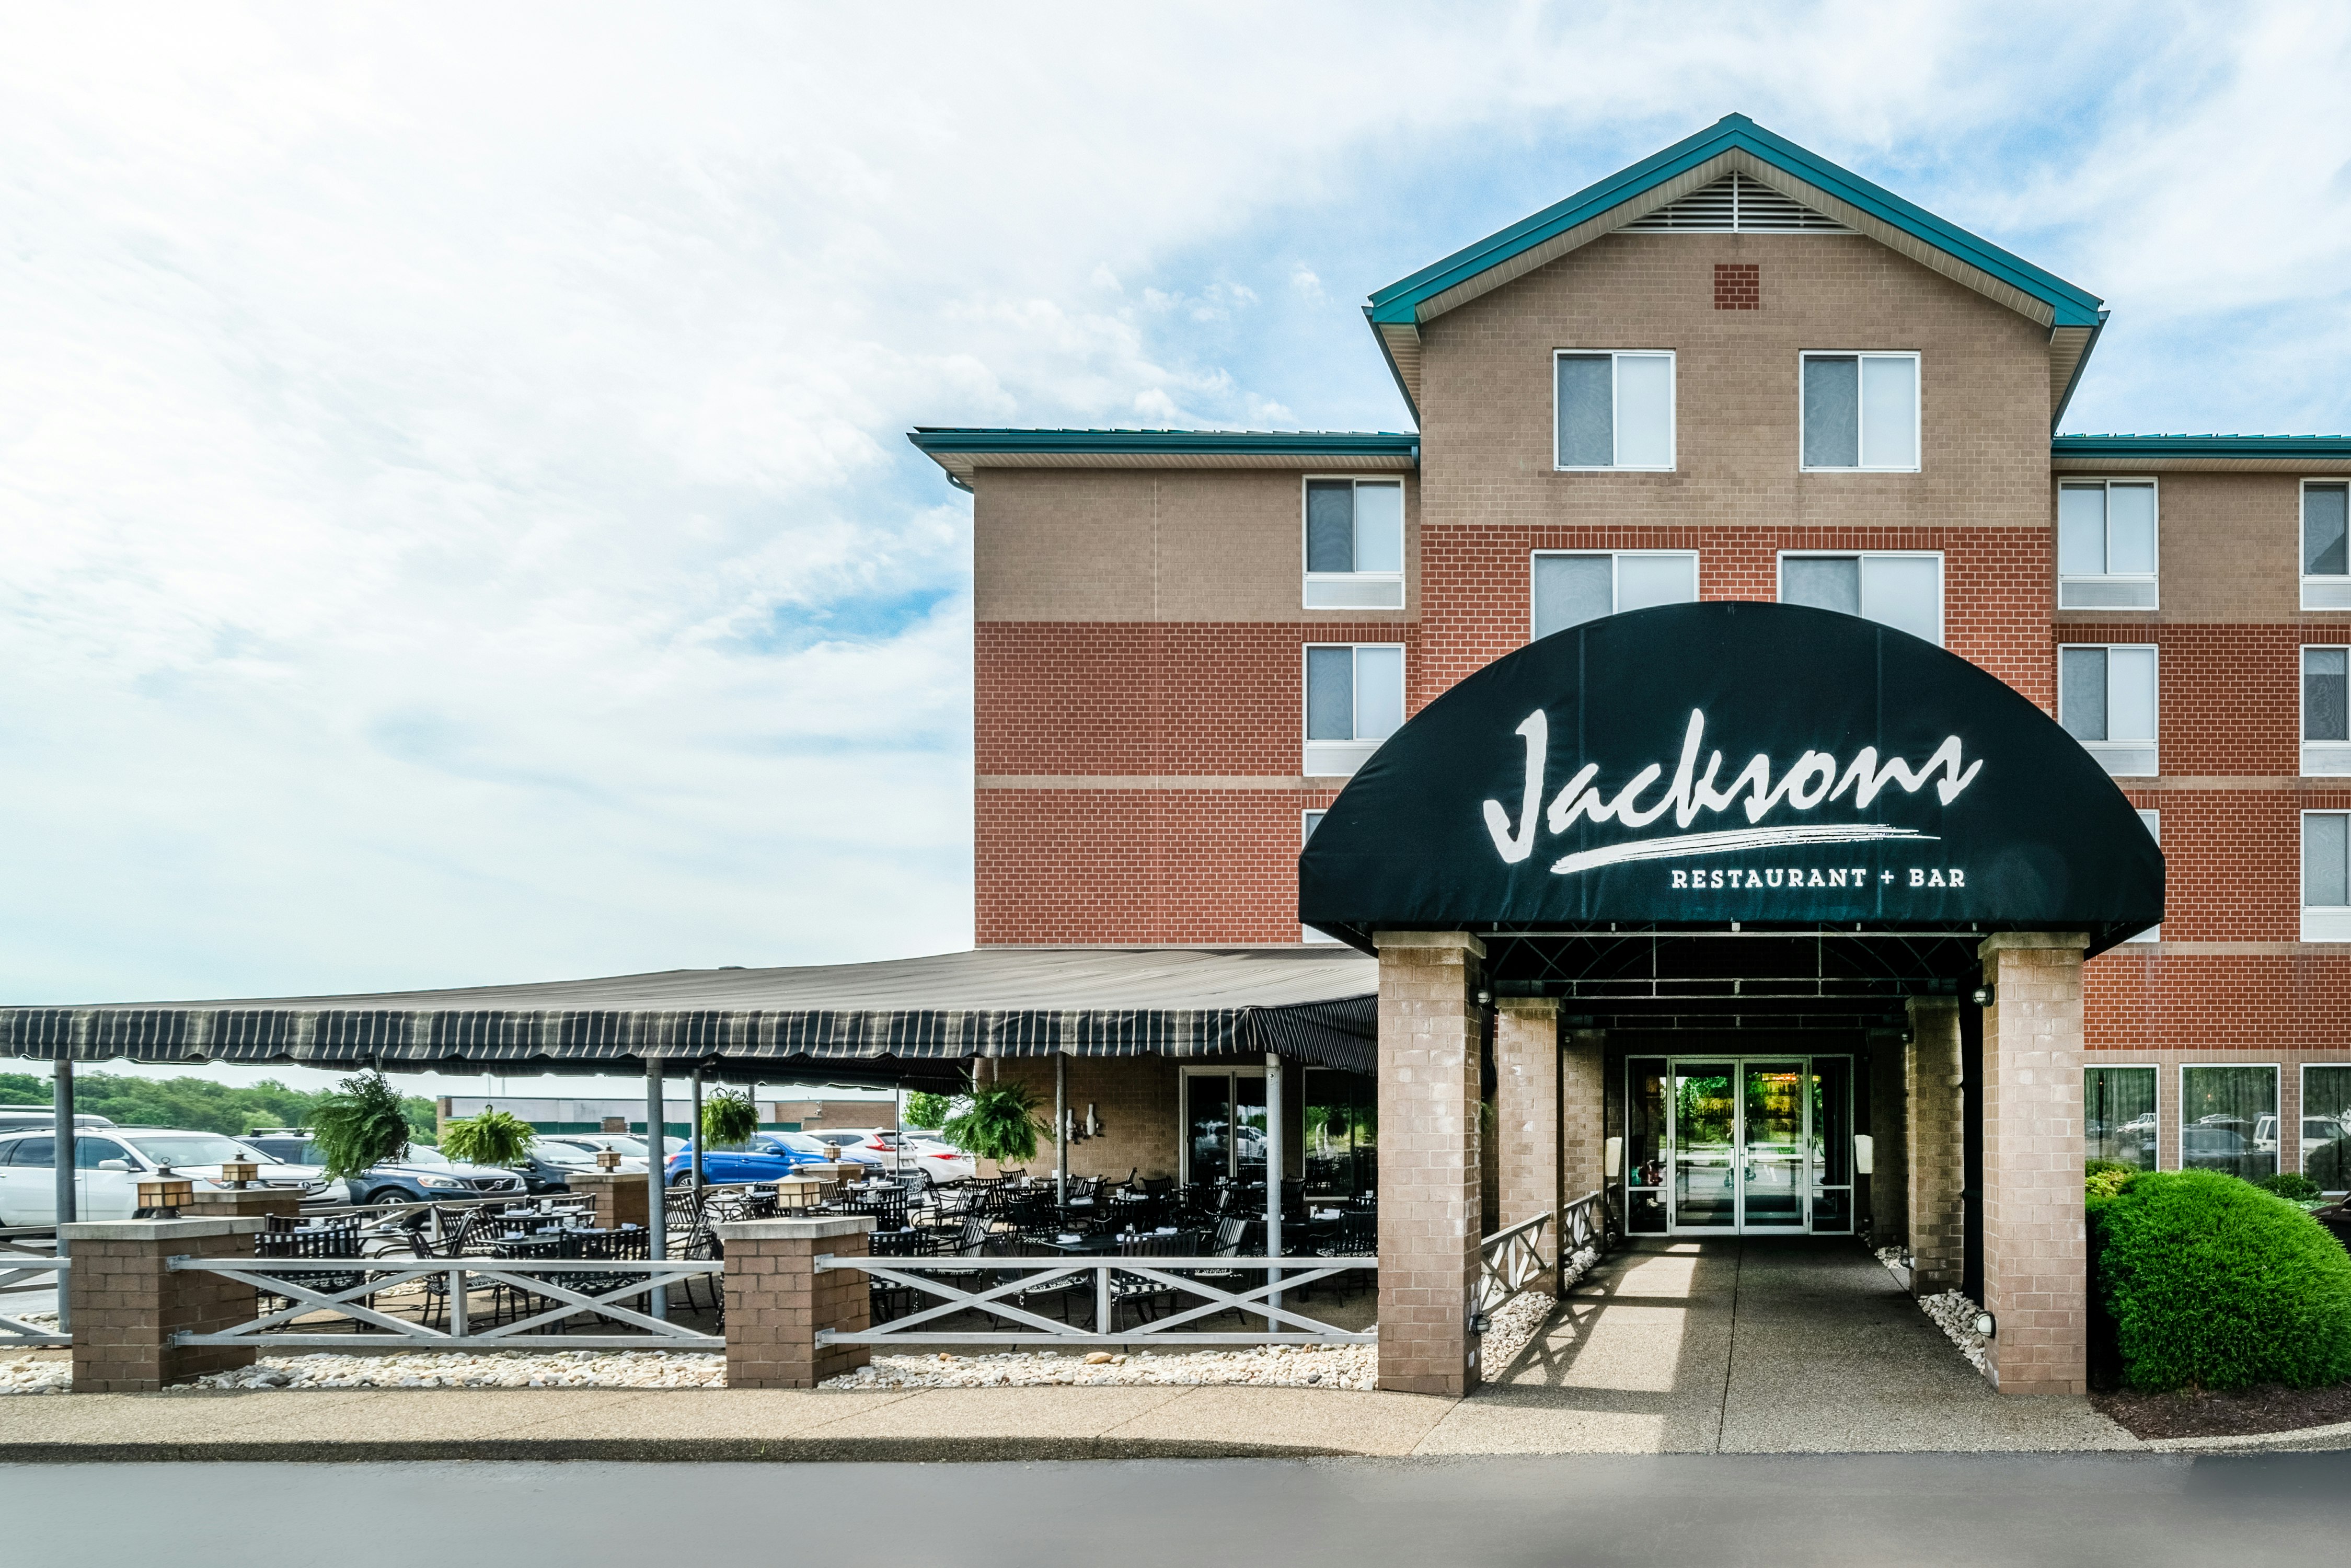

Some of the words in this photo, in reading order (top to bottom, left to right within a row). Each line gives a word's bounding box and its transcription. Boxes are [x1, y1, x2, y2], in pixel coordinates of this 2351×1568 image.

[1483, 707, 1984, 865] Jacksons
[1671, 868, 1867, 889] RESTAURANT
[1880, 870, 1895, 884] +
[1909, 868, 1966, 888] BAR
